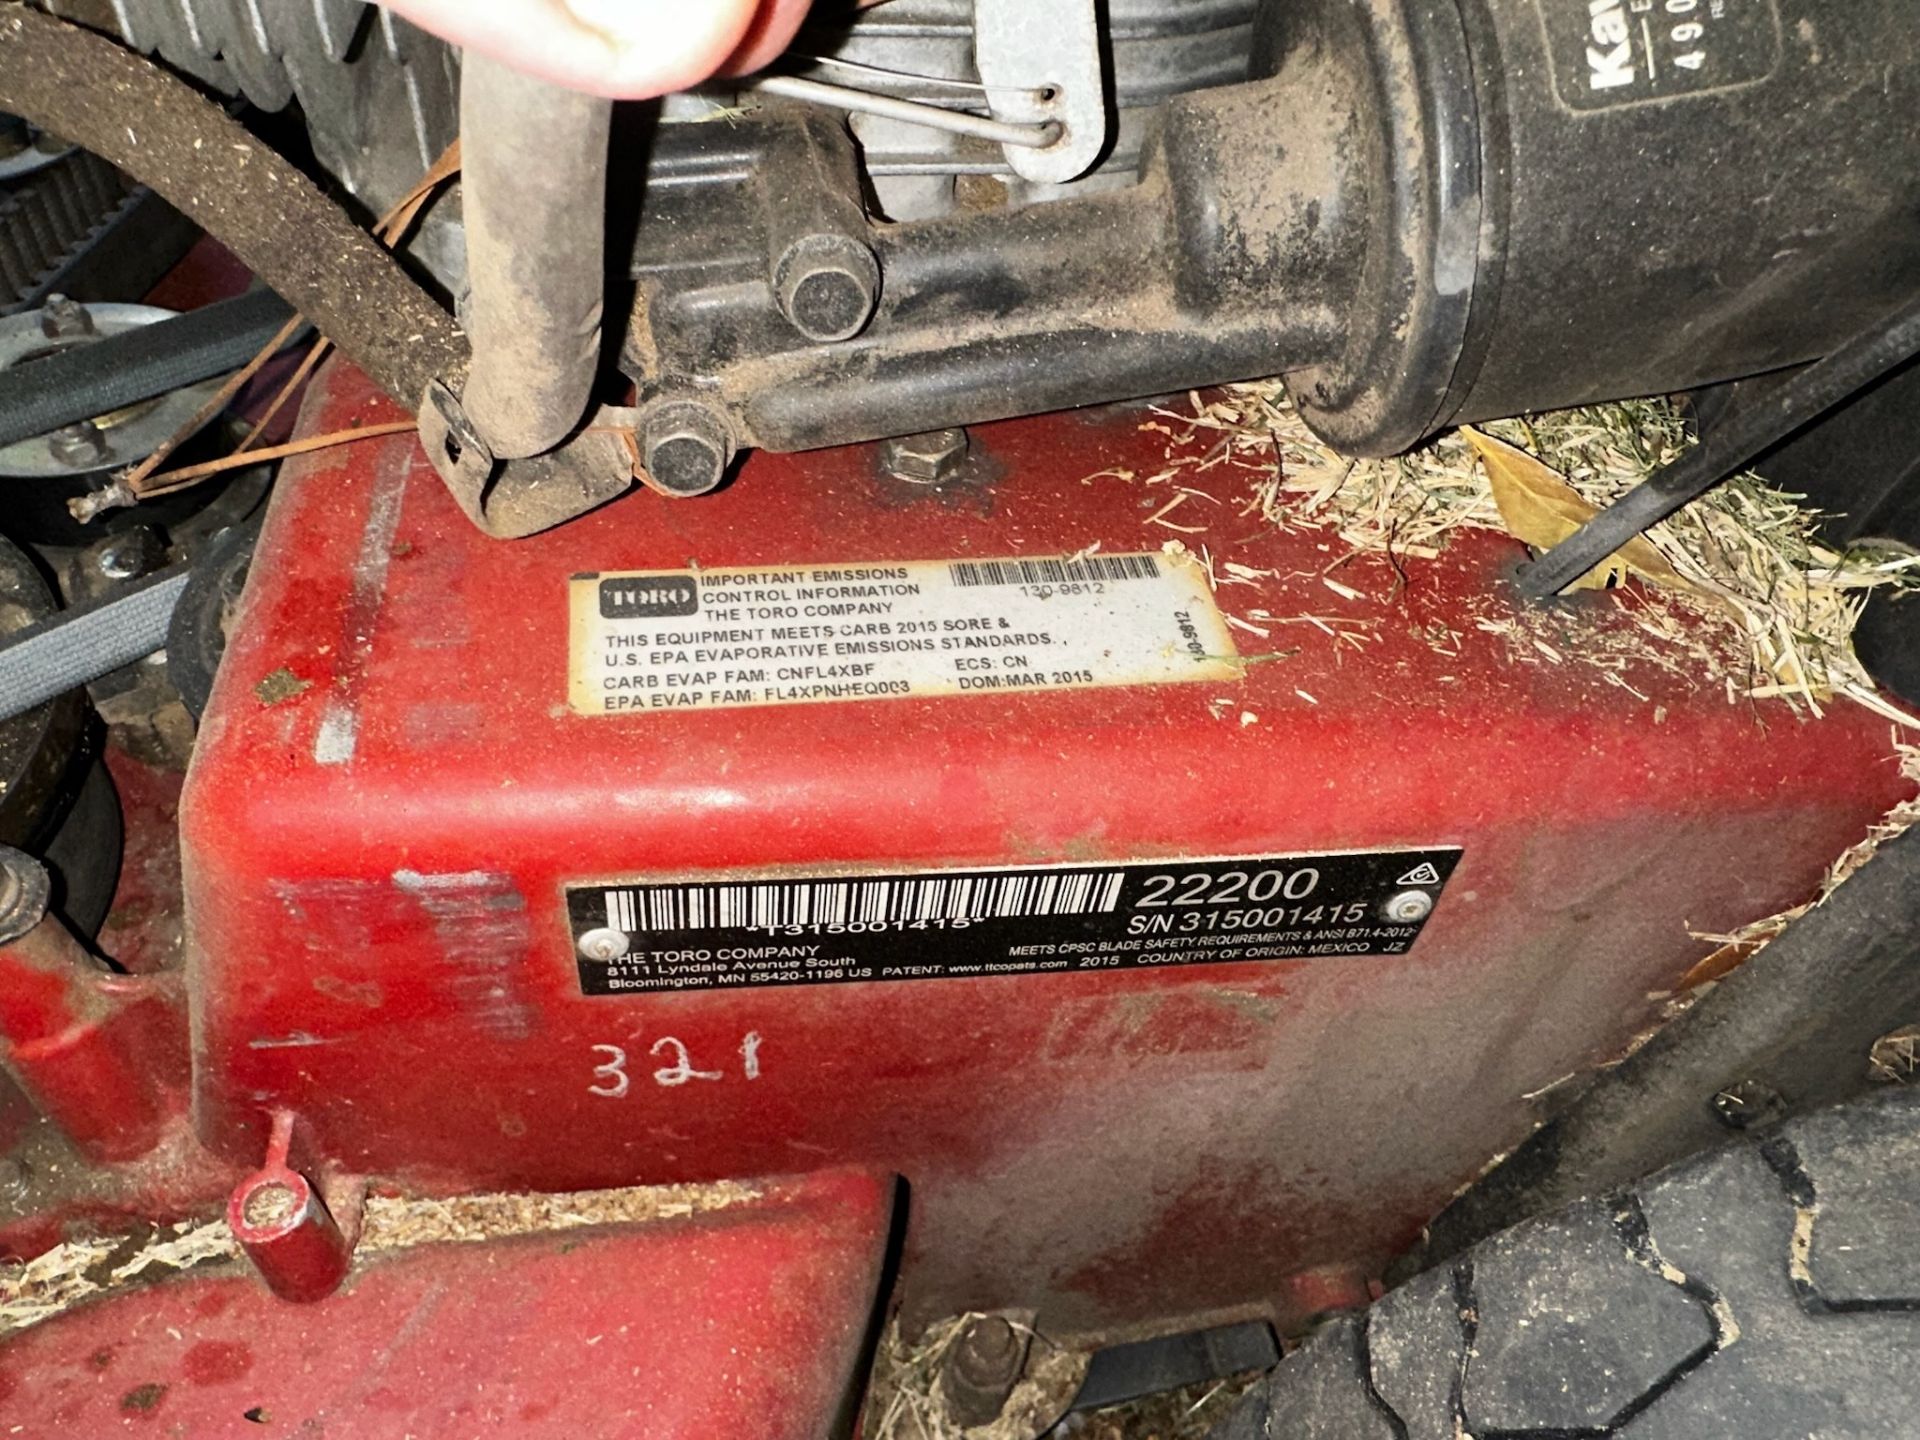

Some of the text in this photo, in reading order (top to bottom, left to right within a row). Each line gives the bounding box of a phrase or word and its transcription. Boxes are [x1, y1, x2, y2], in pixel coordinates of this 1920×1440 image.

[701, 567, 909, 587] IMPORTANT EMISSIONS
[603, 588, 690, 606] TORO
[703, 583, 920, 604] CONTROL INFORMATION
[705, 602, 894, 622] THE TORO COMPANY
[606, 617, 1011, 648] THIS EQUIPMENT MEETS CARB 2015 SORE &
[605, 653, 643, 667] U.S.
[650, 651, 689, 665] EPA
[695, 644, 830, 663] EVAPORATIVE
[836, 639, 937, 655] EMISSIONS
[955, 655, 1029, 671] ECS: CN
[604, 663, 876, 690] CARB EVAP FAM: CNFL4XBF
[1052, 670, 1094, 684] 2015
[605, 695, 645, 709] EPA
[652, 691, 703, 707] EVAP
[711, 689, 757, 704] FAM:
[1135, 868, 1320, 908] 22200
[1127, 903, 1368, 935] S/N 315001415
[1008, 945, 1056, 957] MEETS
[1058, 942, 1097, 954] CPSC
[1098, 940, 1142, 952] BLADE
[1144, 936, 1197, 949] SAFETY
[1198, 931, 1302, 946] REQUIREMENTS
[1303, 930, 1313, 940] &
[1314, 928, 1346, 939] ANSI
[651, 949, 711, 964] TORO
[717, 945, 821, 961] COMPANY
[607, 956, 856, 977] 8111 Lyndale Avenue South
[608, 977, 713, 990] Bloomington,
[718, 973, 746, 984] MN
[849, 967, 872, 978] US
[882, 964, 945, 976] PATENT:
[1079, 955, 1120, 968] 2015
[1137, 950, 1216, 964] COUNTRY
[1219, 948, 1243, 959] OF
[1244, 945, 1306, 958] ORIGIN:
[1307, 941, 1371, 954] MEXICO
[1383, 941, 1406, 952] JZ
